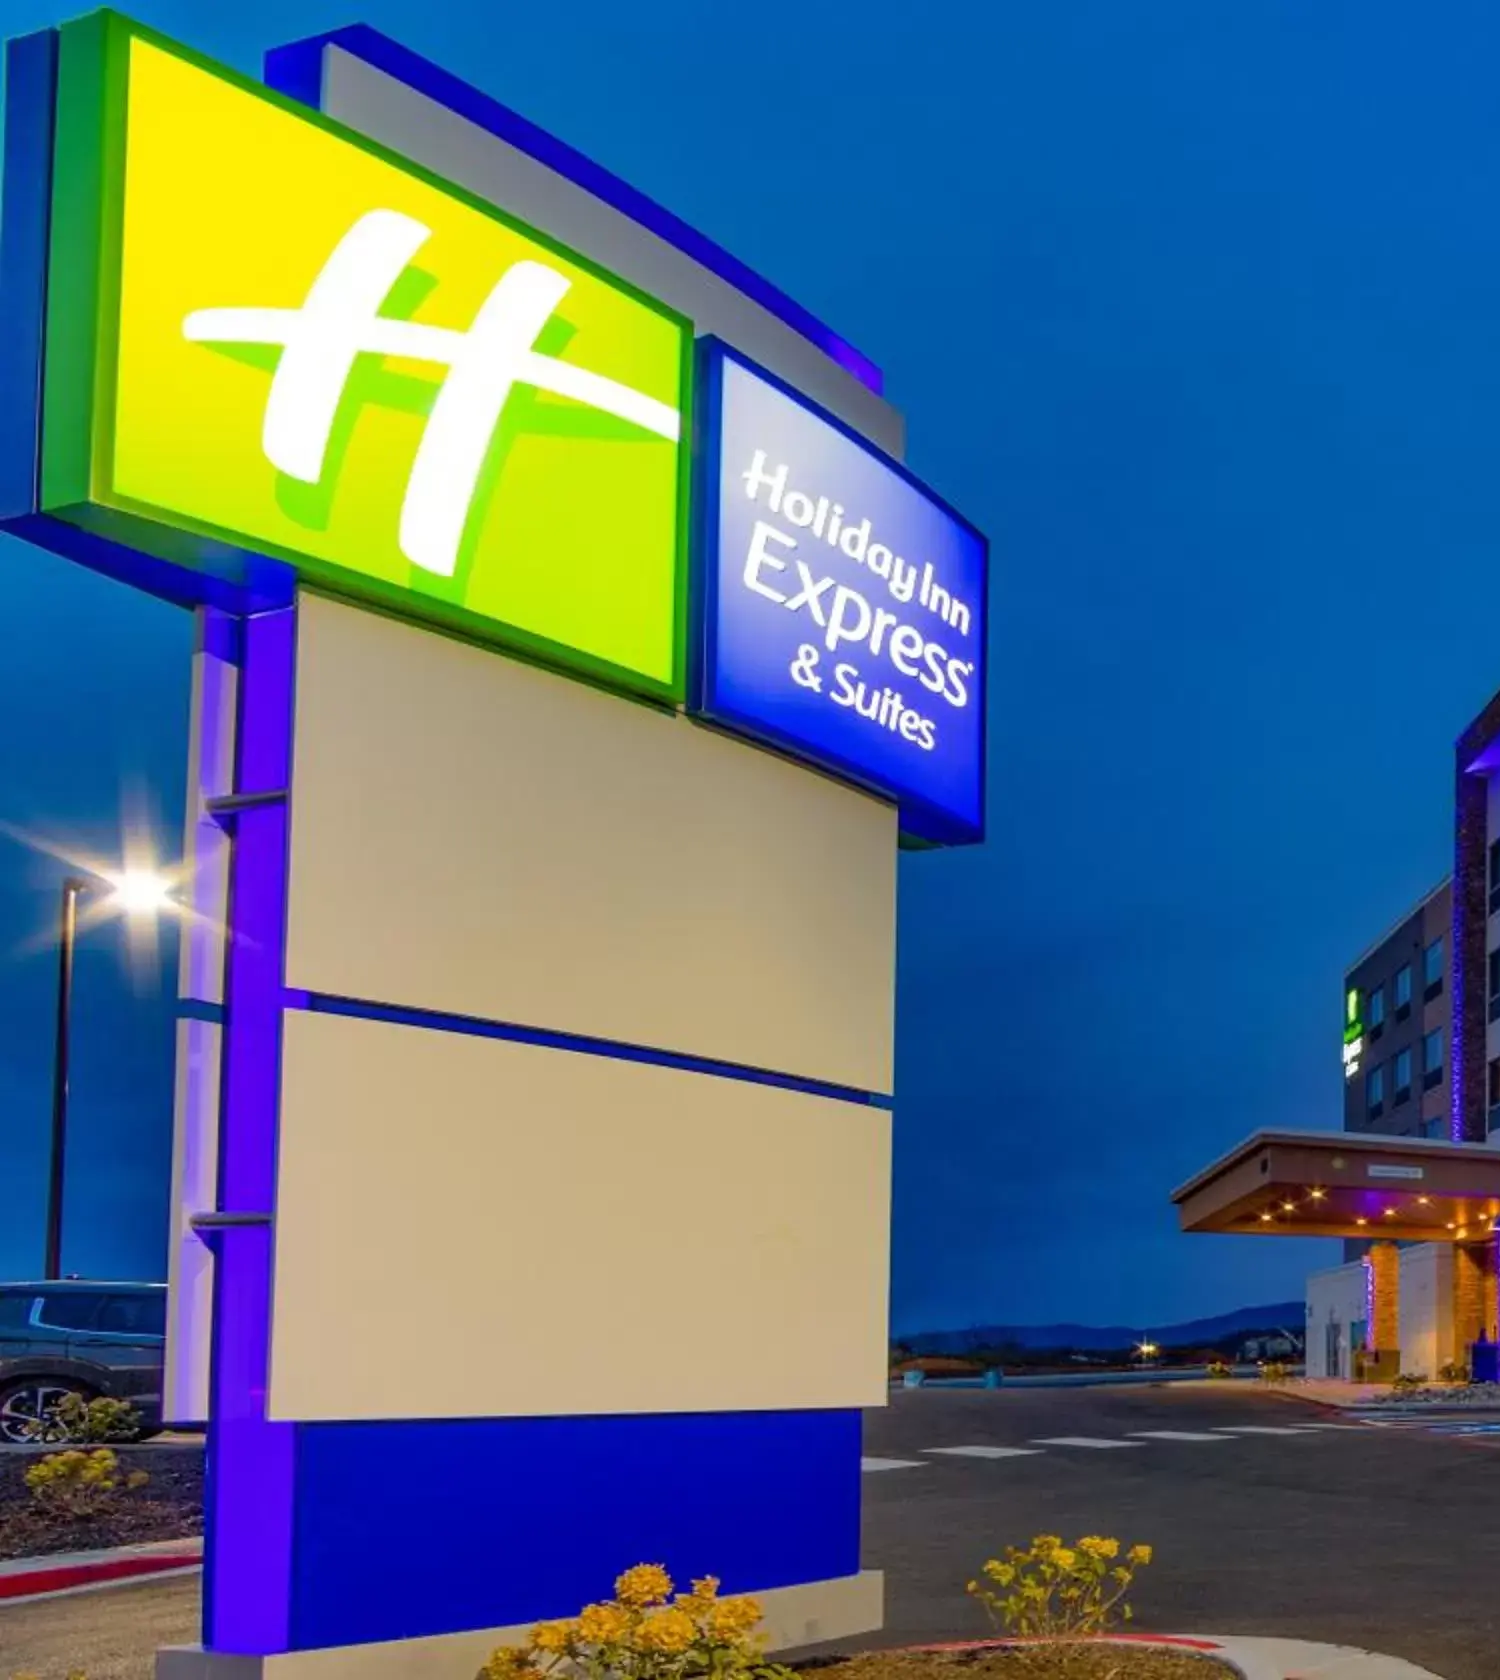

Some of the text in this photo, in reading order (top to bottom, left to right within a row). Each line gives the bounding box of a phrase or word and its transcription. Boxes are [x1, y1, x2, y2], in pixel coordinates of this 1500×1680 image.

[742, 449, 970, 636] Holiday Inn
[790, 644, 936, 750] & Suites
